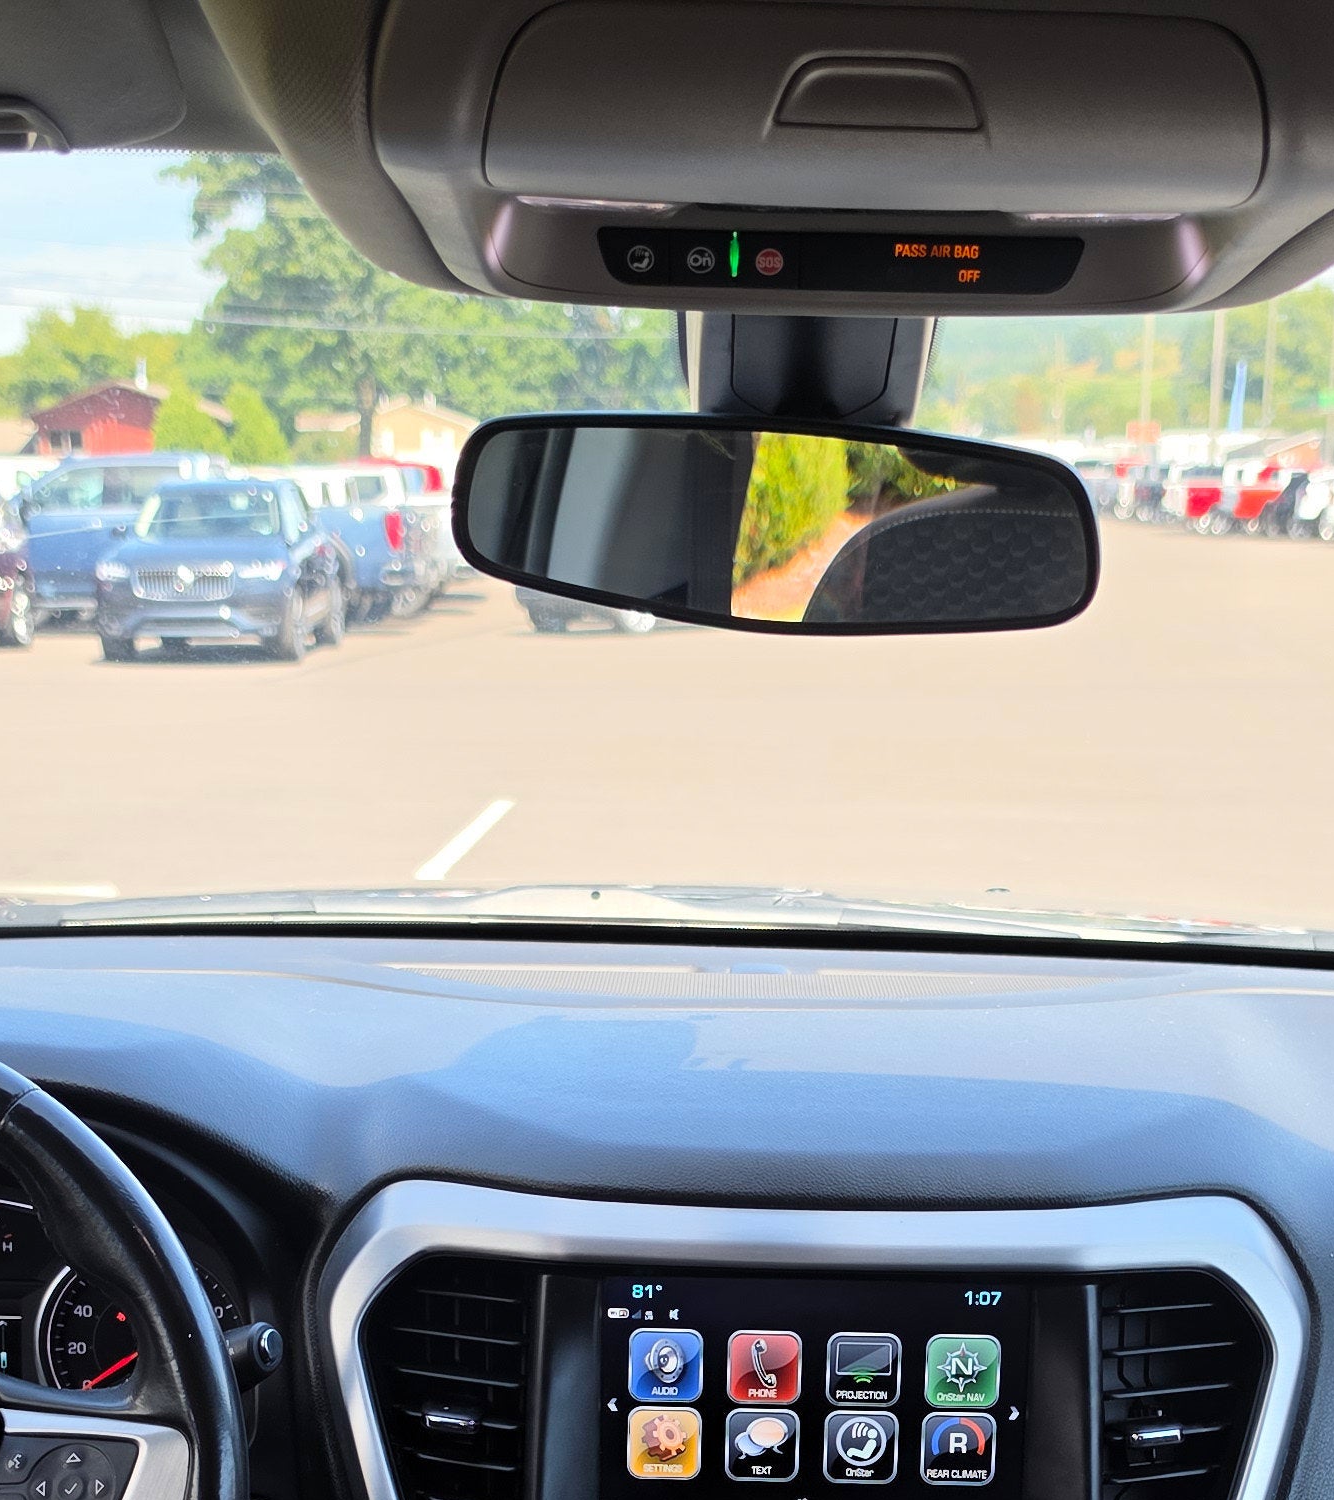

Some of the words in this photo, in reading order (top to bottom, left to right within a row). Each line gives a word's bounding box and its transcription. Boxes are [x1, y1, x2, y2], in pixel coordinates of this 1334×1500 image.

[894, 243, 927, 258] PASS
[930, 244, 951, 258] AIR
[953, 245, 980, 260] BAG
[758, 255, 781, 269] SOS
[958, 269, 981, 283] OFF
[2, 1241, 13, 1253] H
[631, 1284, 663, 1299] 81°
[964, 1291, 1002, 1307] 1:07
[73, 1304, 93, 1318] 40
[67, 1341, 87, 1355] 20
[651, 1385, 679, 1397] AUDIO
[748, 1387, 778, 1399] PHONE
[835, 1389, 888, 1401] PROJECTION
[936, 1391, 965, 1402] OnStar
[966, 1392, 985, 1403] NAV
[948, 1433, 968, 1455] R
[642, 1463, 684, 1474] SETTINGS
[751, 1465, 773, 1476] TEXT
[845, 1467, 875, 1478] OnStar
[926, 1468, 950, 1480] REAR
[951, 1468, 988, 1480] CLIMATE
